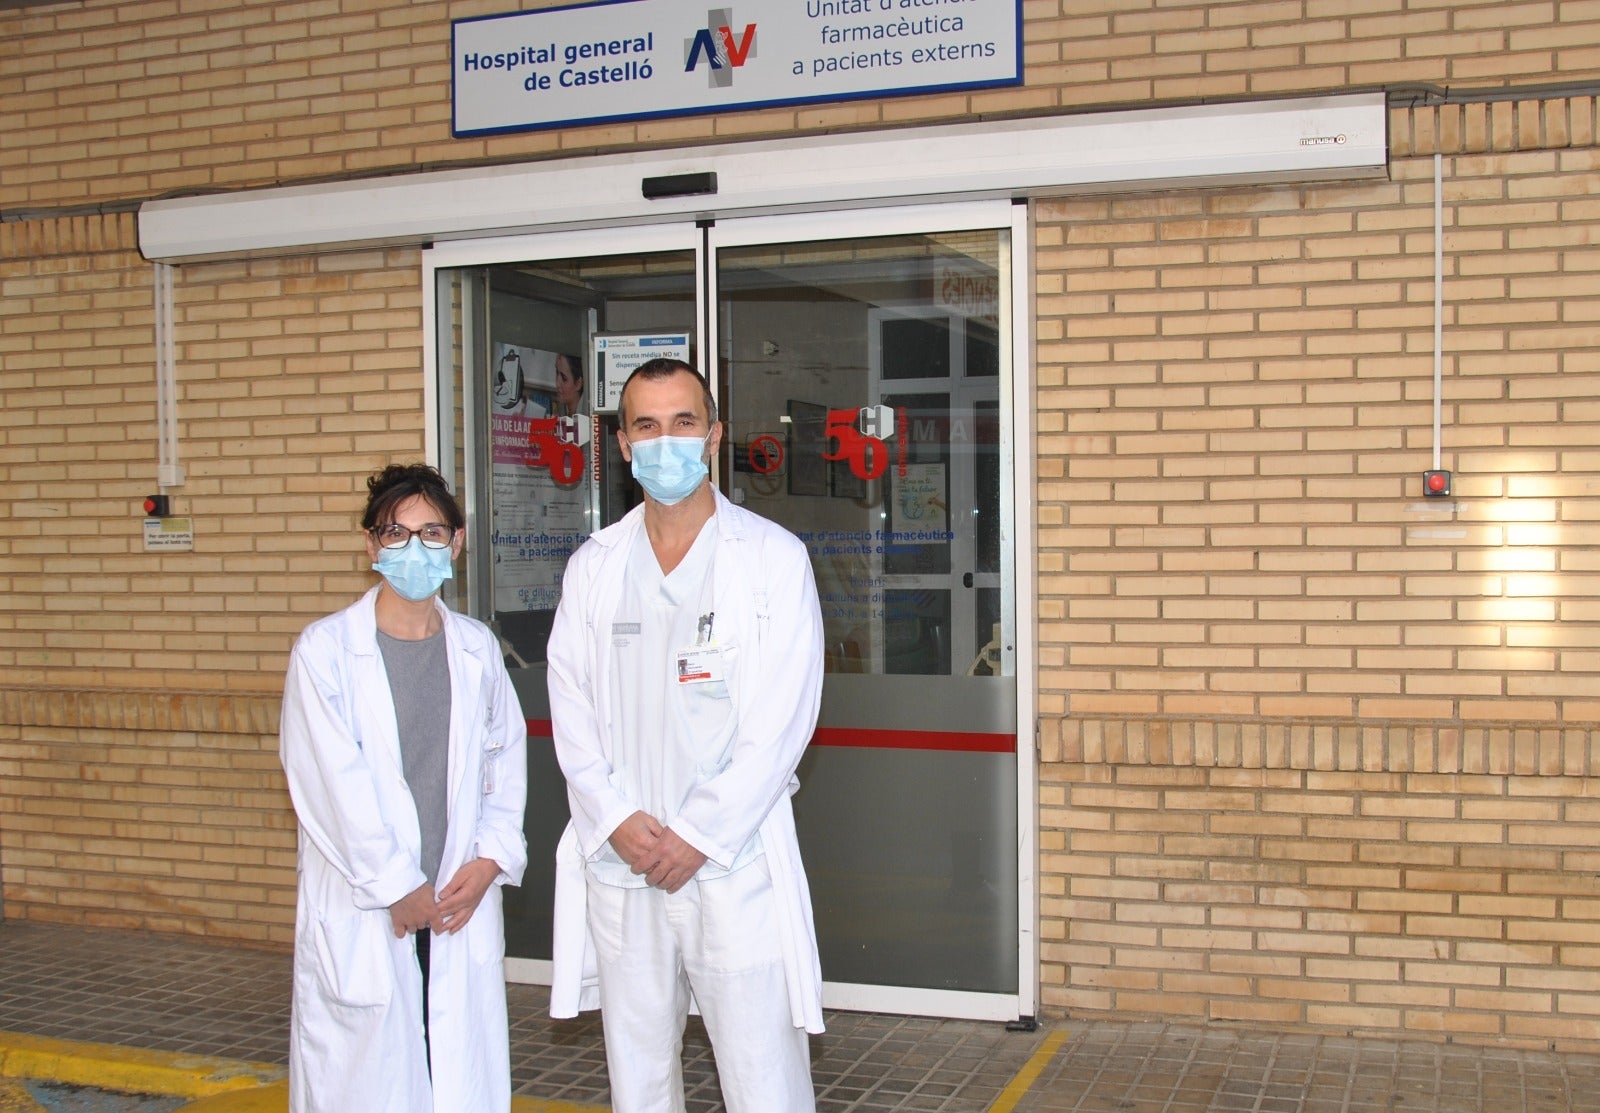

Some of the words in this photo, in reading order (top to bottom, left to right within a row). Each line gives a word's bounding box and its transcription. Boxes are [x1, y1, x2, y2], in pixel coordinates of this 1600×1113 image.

[807, 0, 872, 18] Unitat
[821, 16, 964, 44] farmacèutica
[464, 43, 556, 71] Hospital
[564, 32, 653, 64] general
[792, 61, 804, 75] a
[813, 49, 903, 77] pacients
[911, 41, 996, 63] externs
[524, 72, 551, 91] de
[559, 58, 653, 87] Castelló
[1300, 136, 1336, 146] manusa
[503, 420, 513, 432] DE
[514, 421, 523, 433] LA
[526, 415, 585, 485] 50
[822, 406, 889, 480] 50
[492, 533, 521, 544] Unitat
[524, 533, 573, 544] d'atenció
[818, 530, 872, 540] d'atenció
[876, 530, 954, 540] farmacèutica
[519, 548, 526, 556] a
[529, 547, 572, 557] pacients
[812, 546, 819, 554] a
[822, 545, 872, 556] pacients
[518, 588, 529, 596] de
